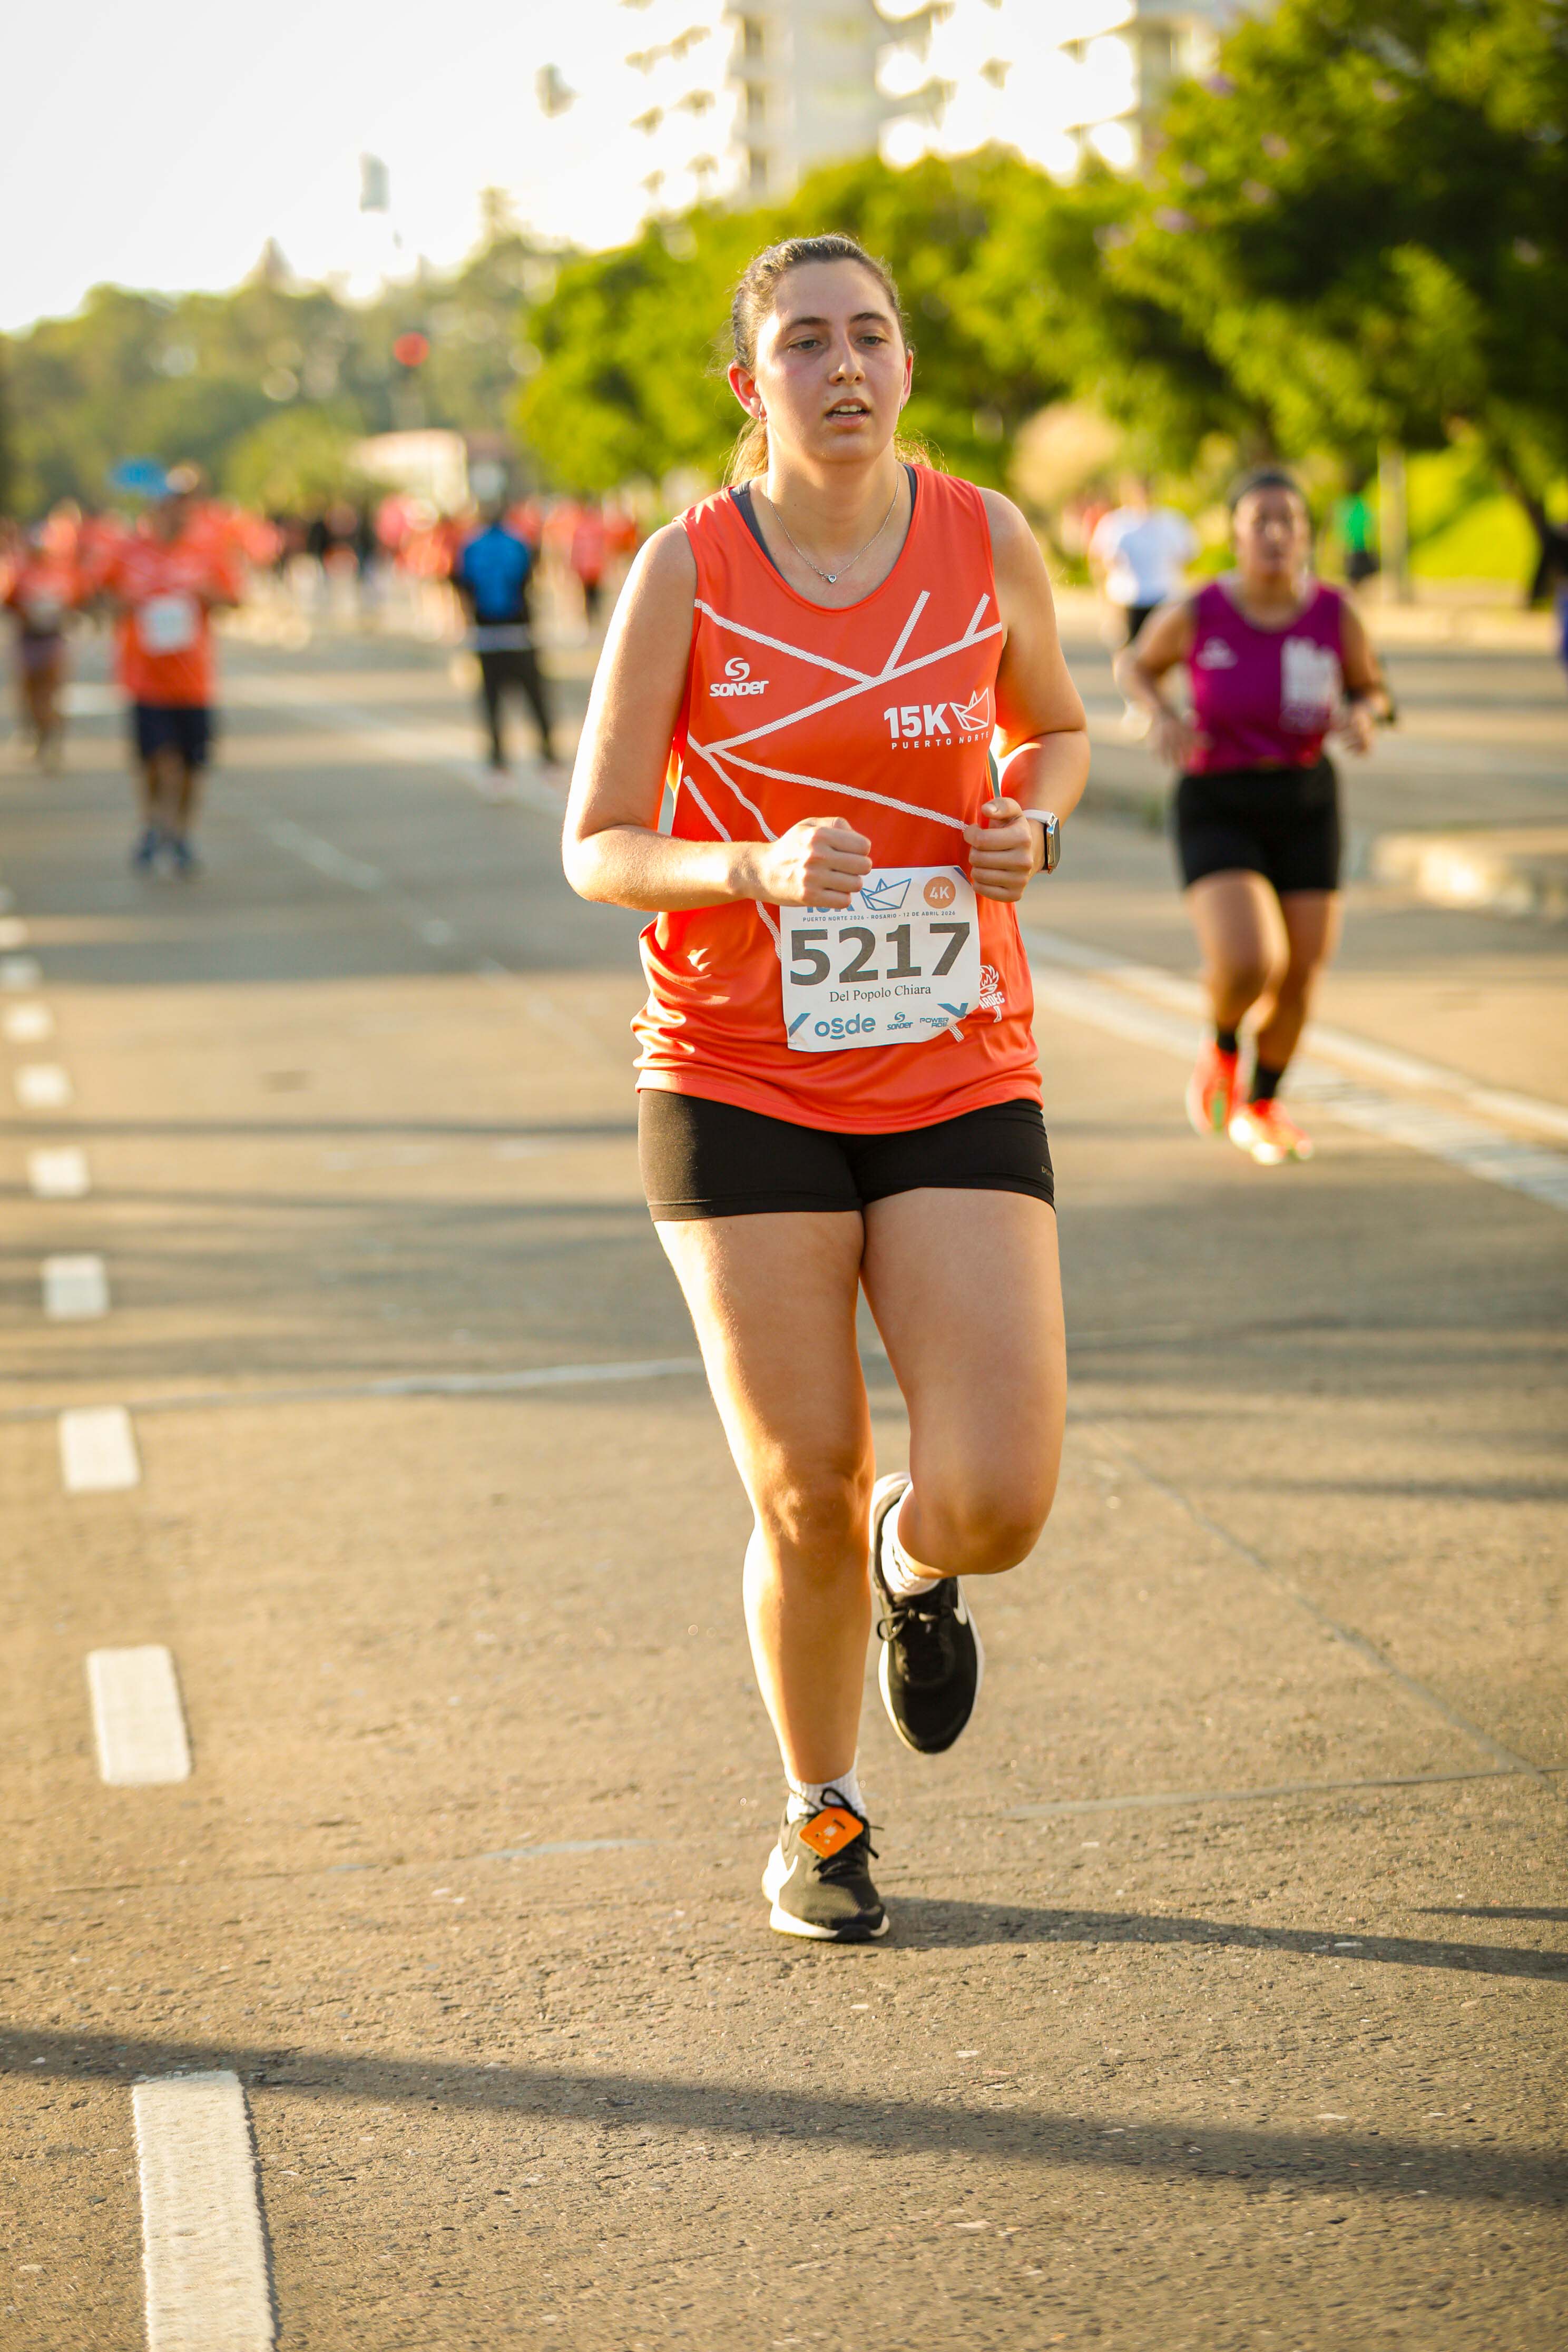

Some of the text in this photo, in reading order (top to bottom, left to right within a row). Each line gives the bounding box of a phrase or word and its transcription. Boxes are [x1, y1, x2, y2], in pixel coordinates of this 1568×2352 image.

[884, 703, 951, 739] 15K
[891, 731, 989, 750] PUERTO NORTE
[929, 885, 950, 899] 4K
[790, 922, 970, 986] 5217
[829, 983, 932, 1003] Del Popolo Chiara
[814, 1013, 876, 1040] osde
